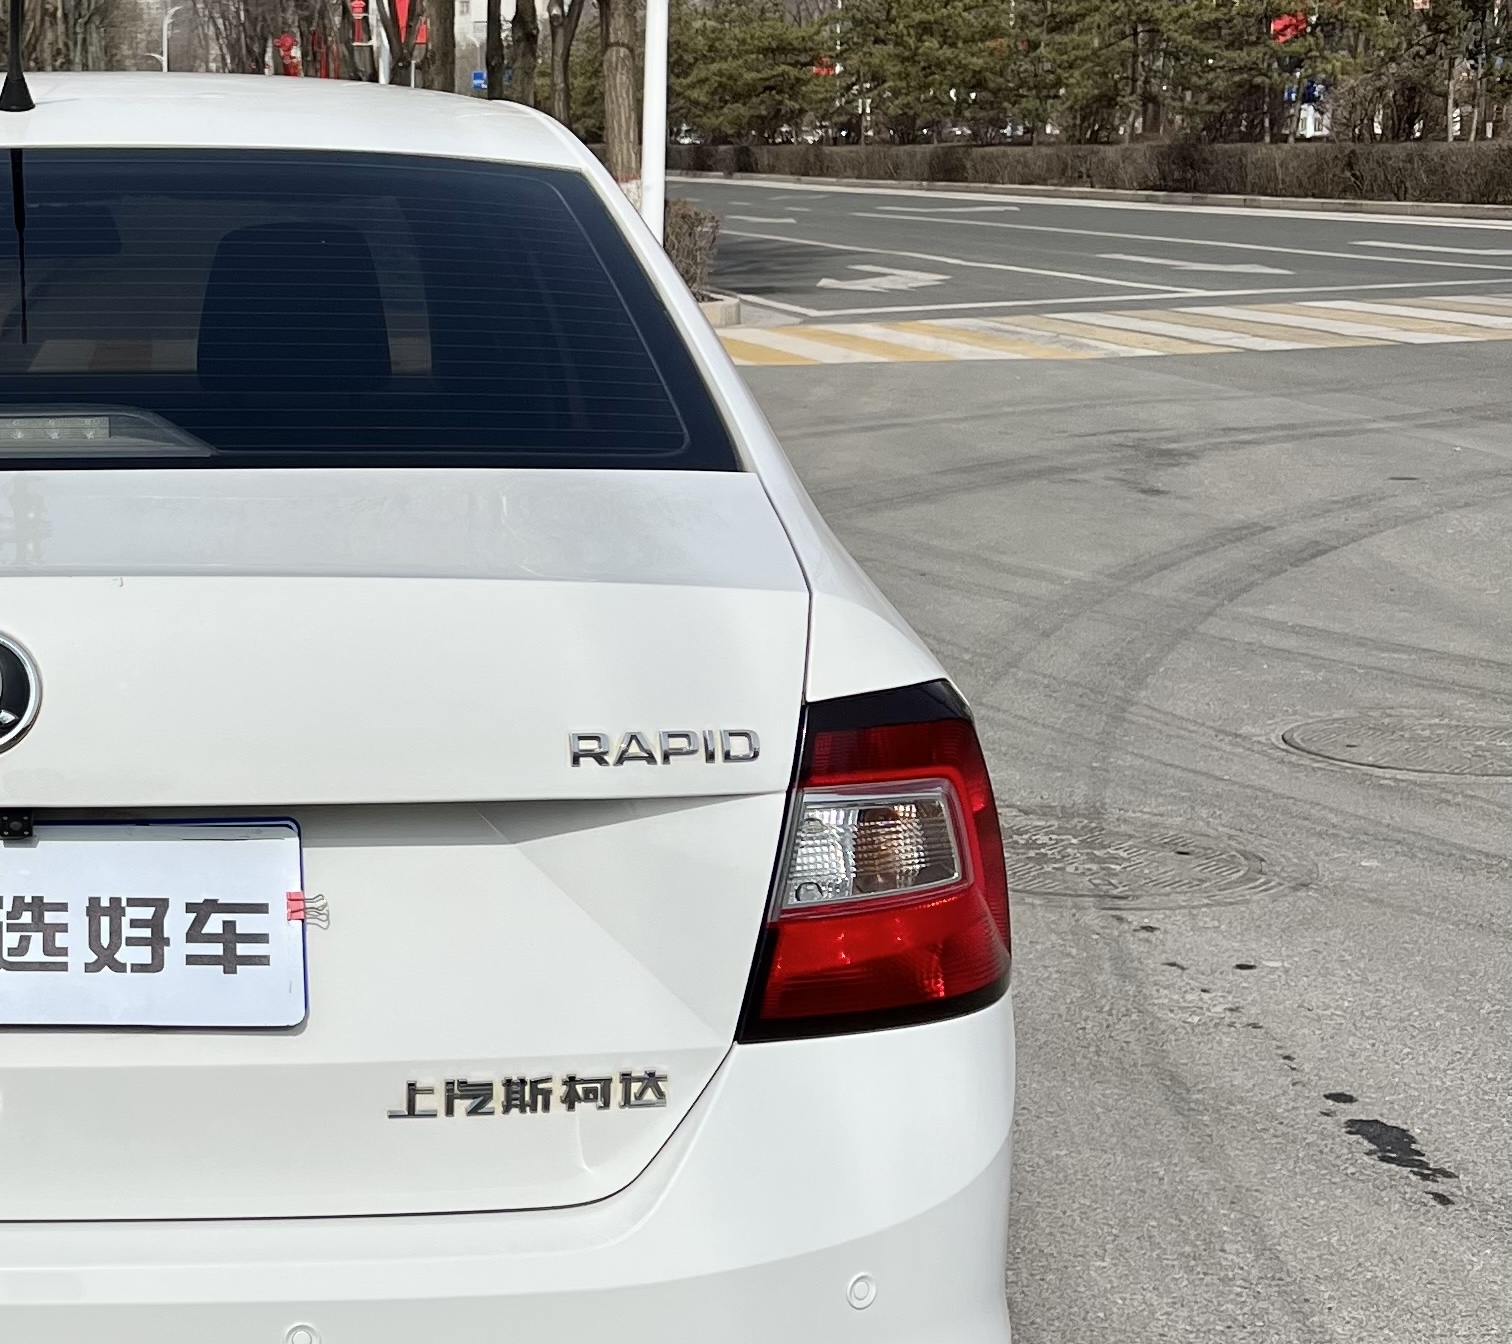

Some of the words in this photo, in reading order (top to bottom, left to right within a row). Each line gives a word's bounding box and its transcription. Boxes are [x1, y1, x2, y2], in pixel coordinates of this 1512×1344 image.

[568, 729, 761, 768] RAPID
[387, 1067, 669, 1119] 上汽斯柯达
